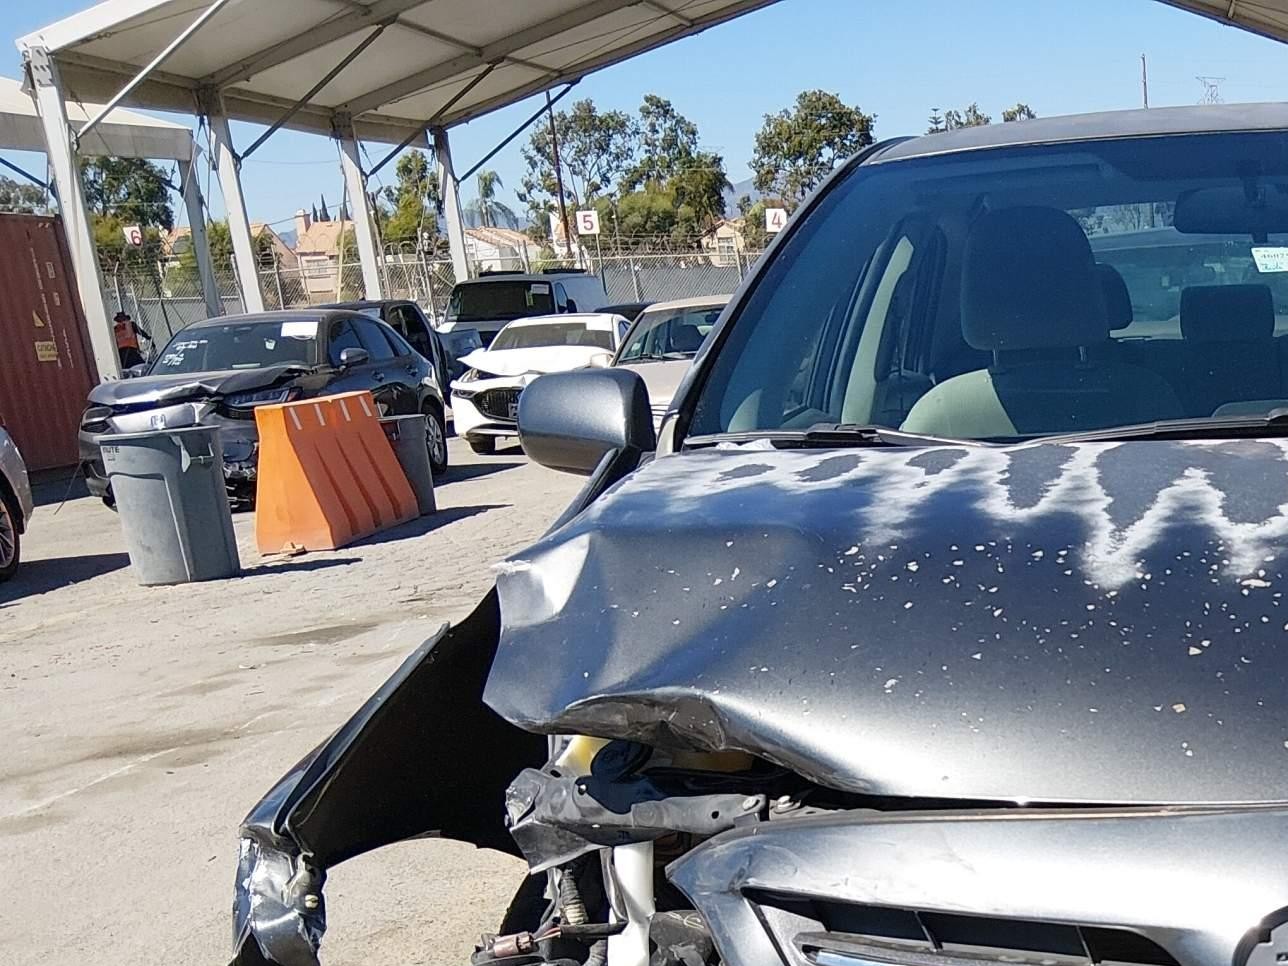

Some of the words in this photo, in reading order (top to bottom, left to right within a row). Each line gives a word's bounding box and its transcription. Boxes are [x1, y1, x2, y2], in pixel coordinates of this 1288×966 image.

[582, 213, 594, 231] 5
[771, 211, 783, 229] 4
[130, 229, 142, 247] 6
